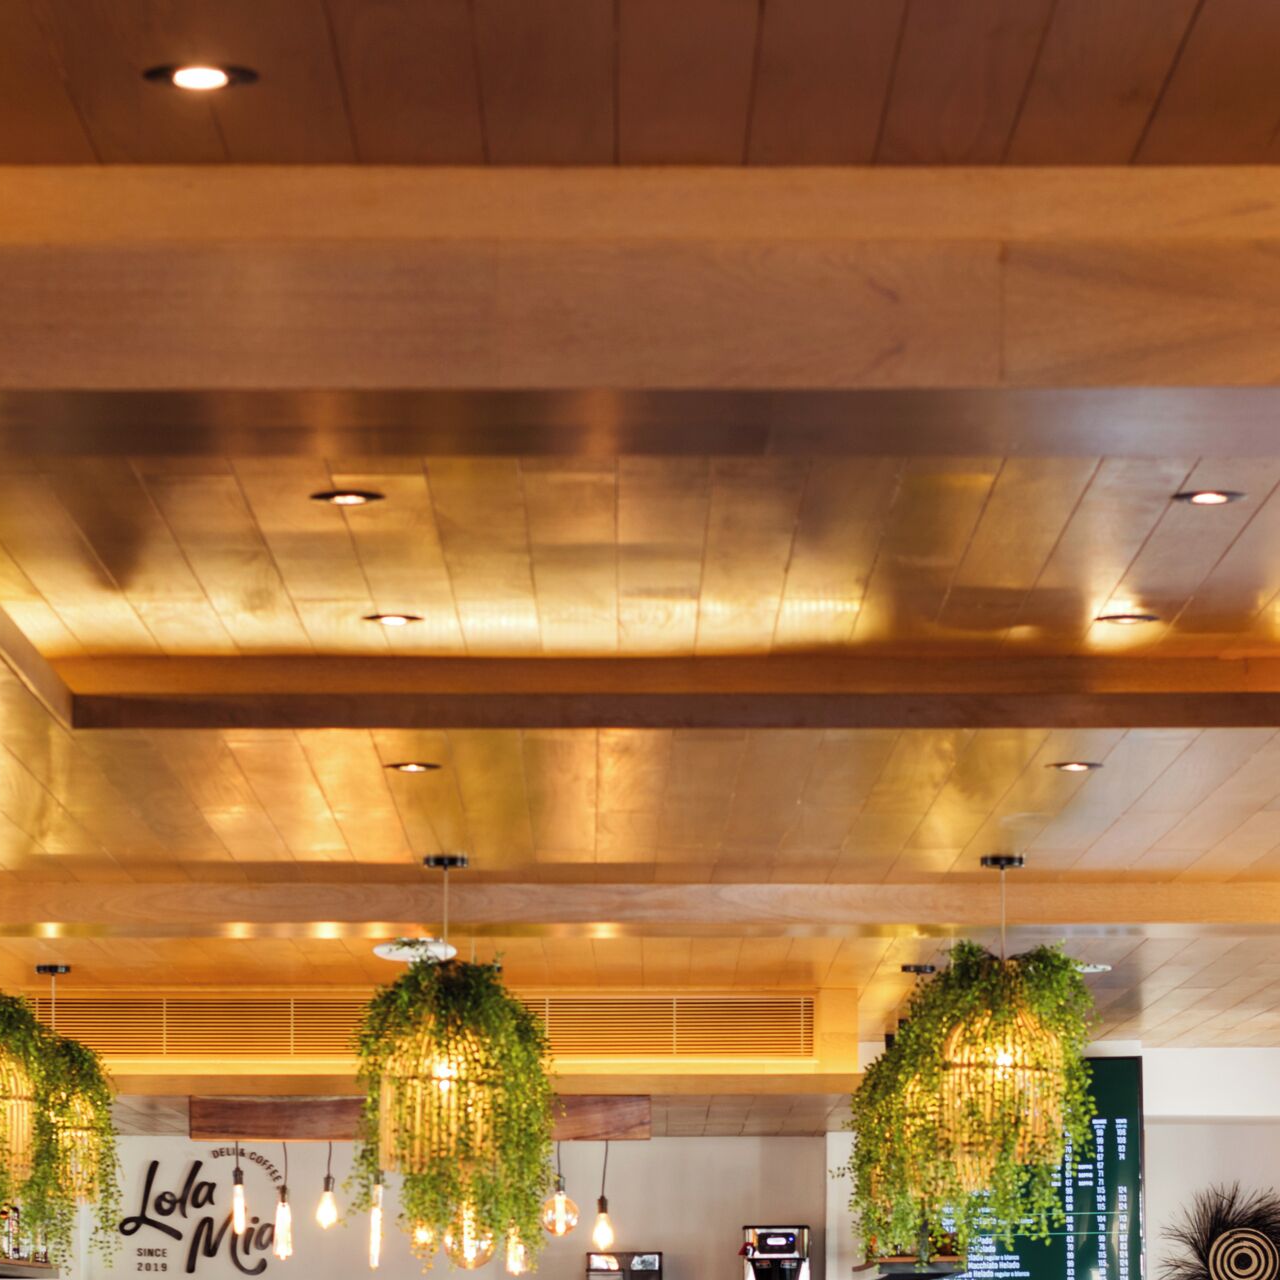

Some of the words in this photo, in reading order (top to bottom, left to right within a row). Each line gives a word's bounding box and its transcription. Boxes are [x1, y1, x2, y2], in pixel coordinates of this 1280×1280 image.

[212, 1148, 236, 1158] DELI
[248, 1152, 282, 1182] COFFEE
[119, 1160, 216, 1241] Lola
[137, 1248, 167, 1257] SINCE
[137, 1263, 168, 1272] 2019
